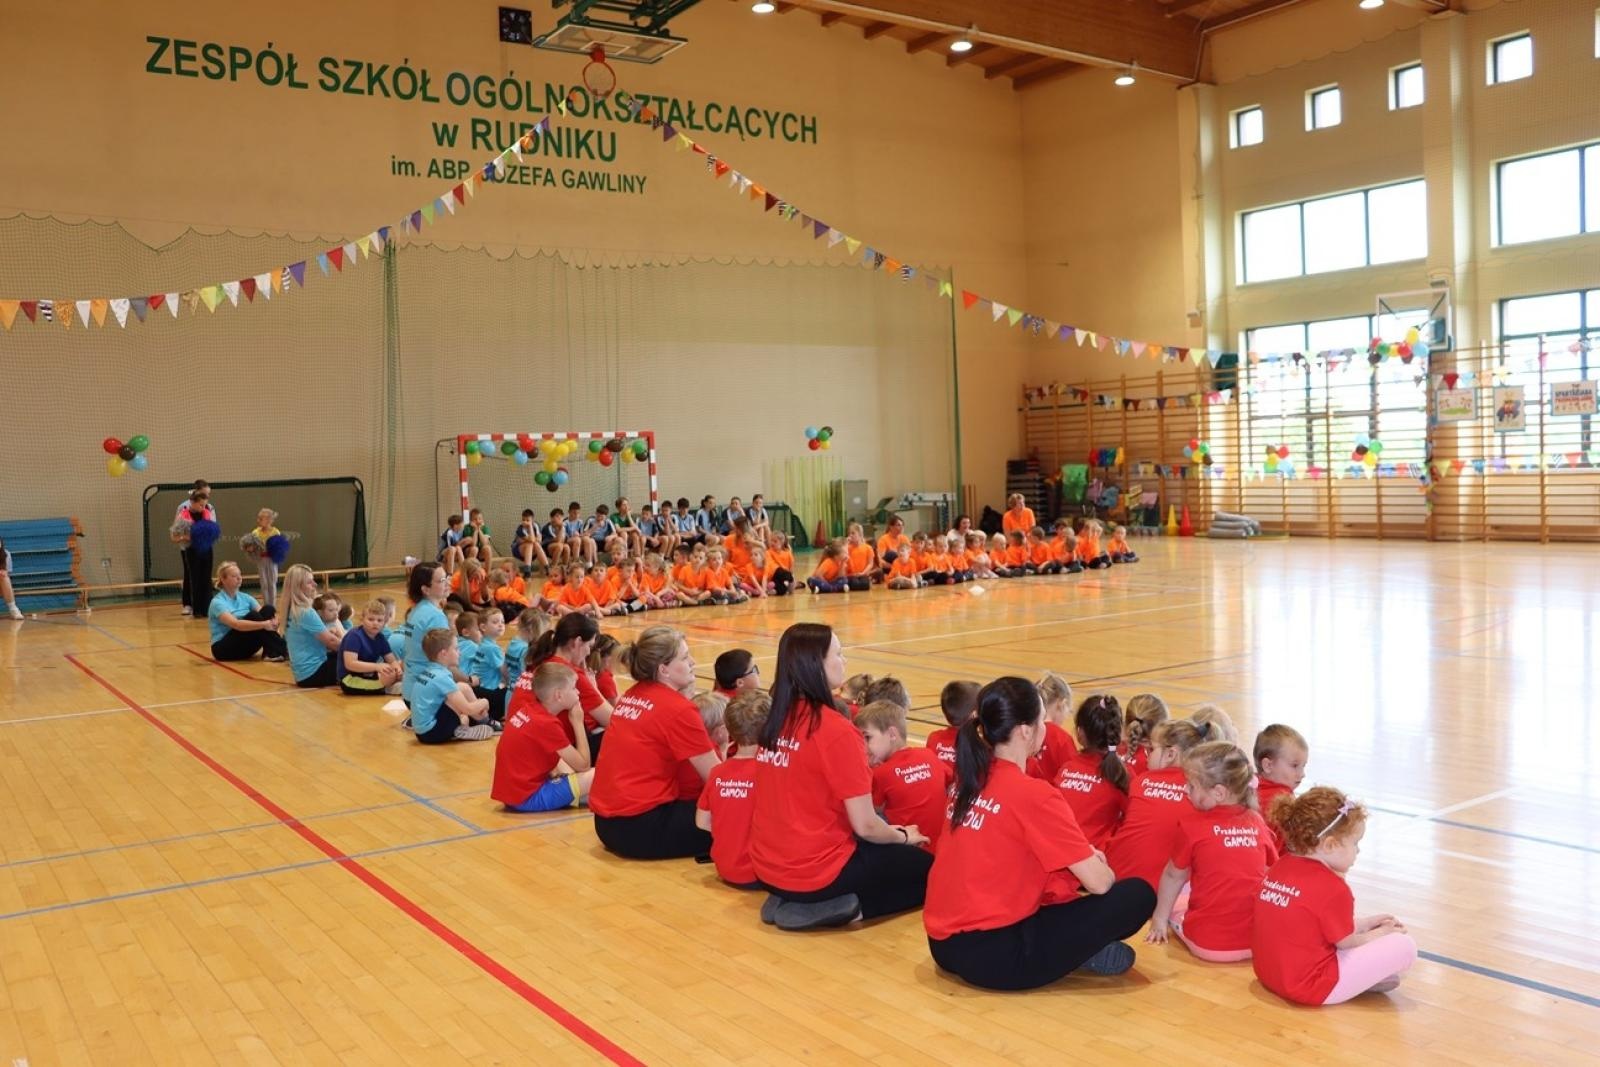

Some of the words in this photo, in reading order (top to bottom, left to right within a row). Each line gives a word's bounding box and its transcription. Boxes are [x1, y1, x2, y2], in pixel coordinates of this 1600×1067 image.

[146, 36, 308, 89] ZESPÓŁ
[318, 56, 440, 103] SZKÓŁ
[432, 122, 459, 148] w
[471, 118, 618, 162] RUDNIKU
[391, 155, 421, 177] im.
[562, 168, 647, 194] GAWLINY
